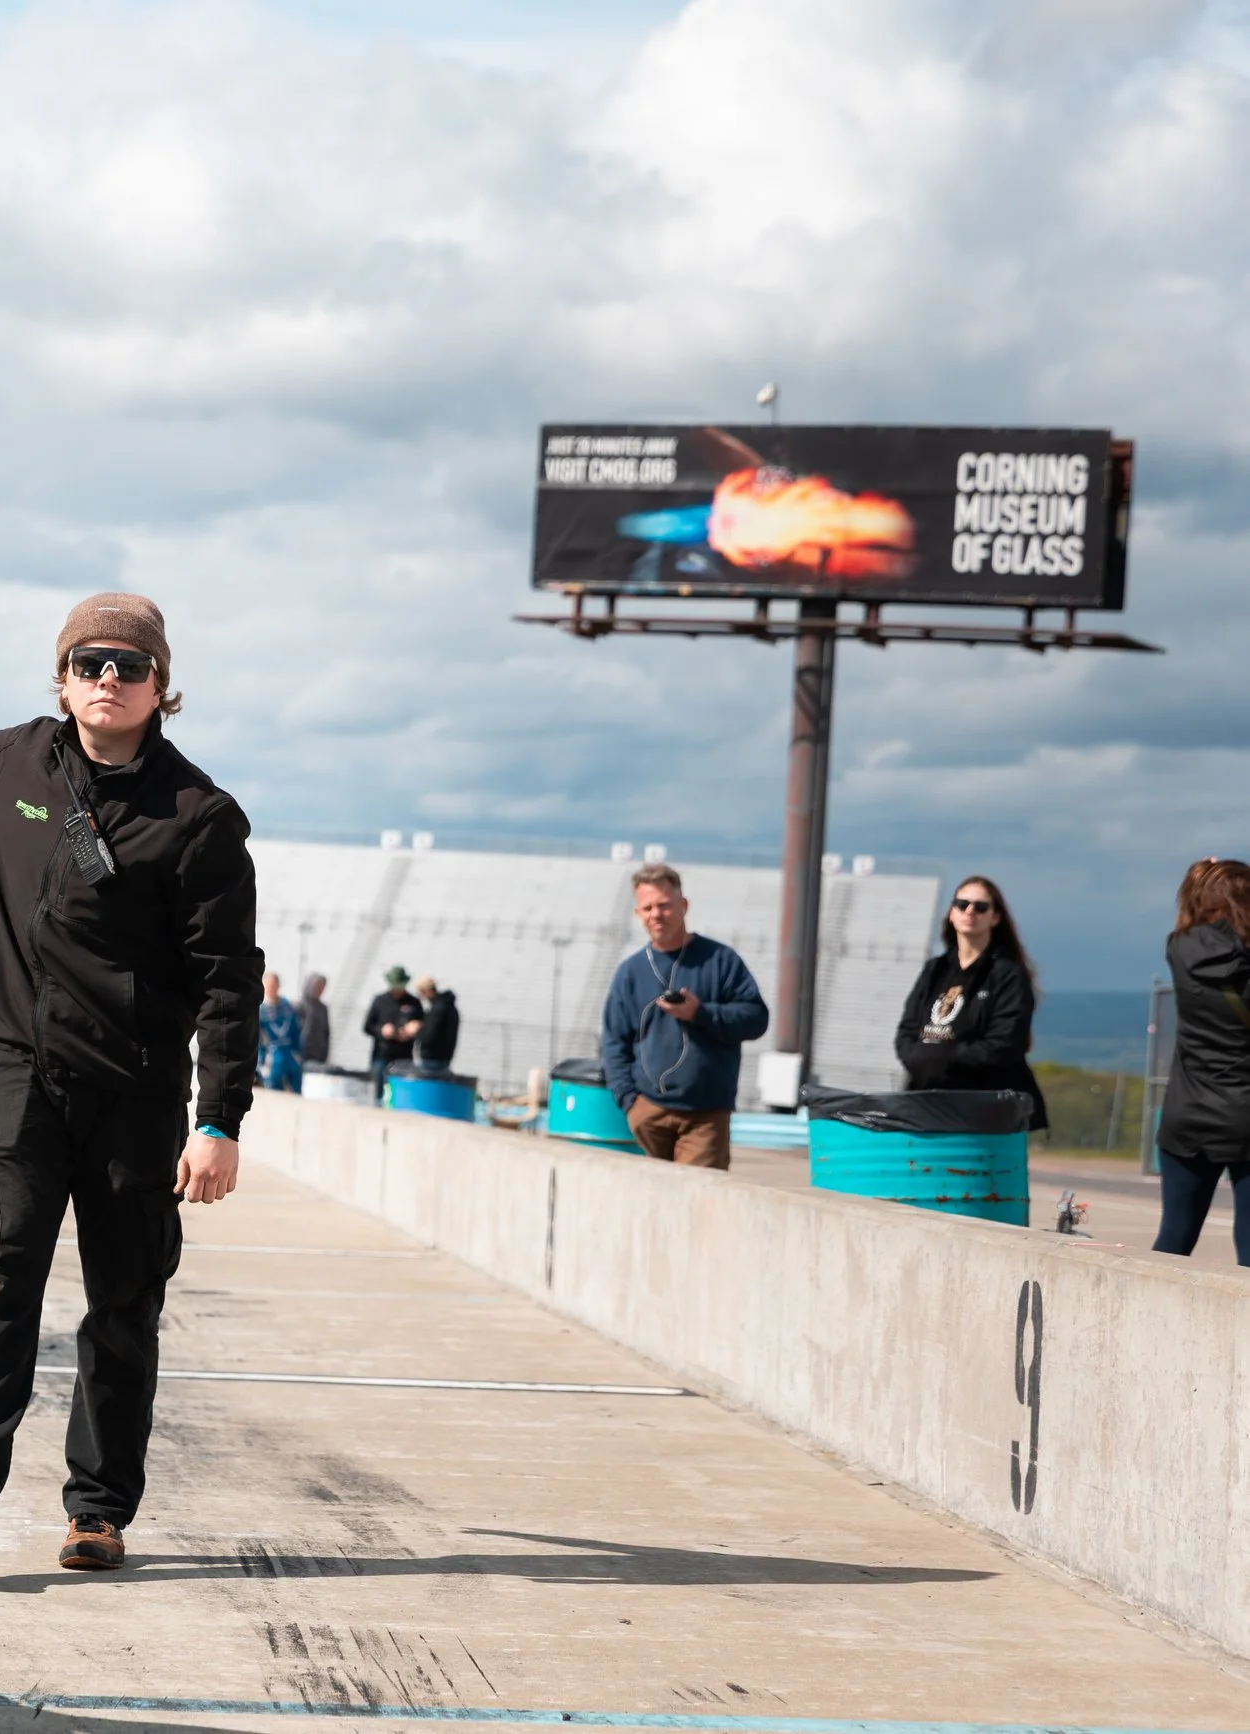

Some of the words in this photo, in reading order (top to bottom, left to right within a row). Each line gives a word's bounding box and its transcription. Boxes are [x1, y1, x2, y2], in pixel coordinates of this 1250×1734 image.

[545, 457, 588, 483] VISIT
[588, 457, 677, 485] CMOG.ORG
[956, 452, 1090, 495] CORNING
[953, 492, 1087, 536] MUSEUM
[951, 532, 992, 574] OF
[991, 533, 1085, 577] GLASS
